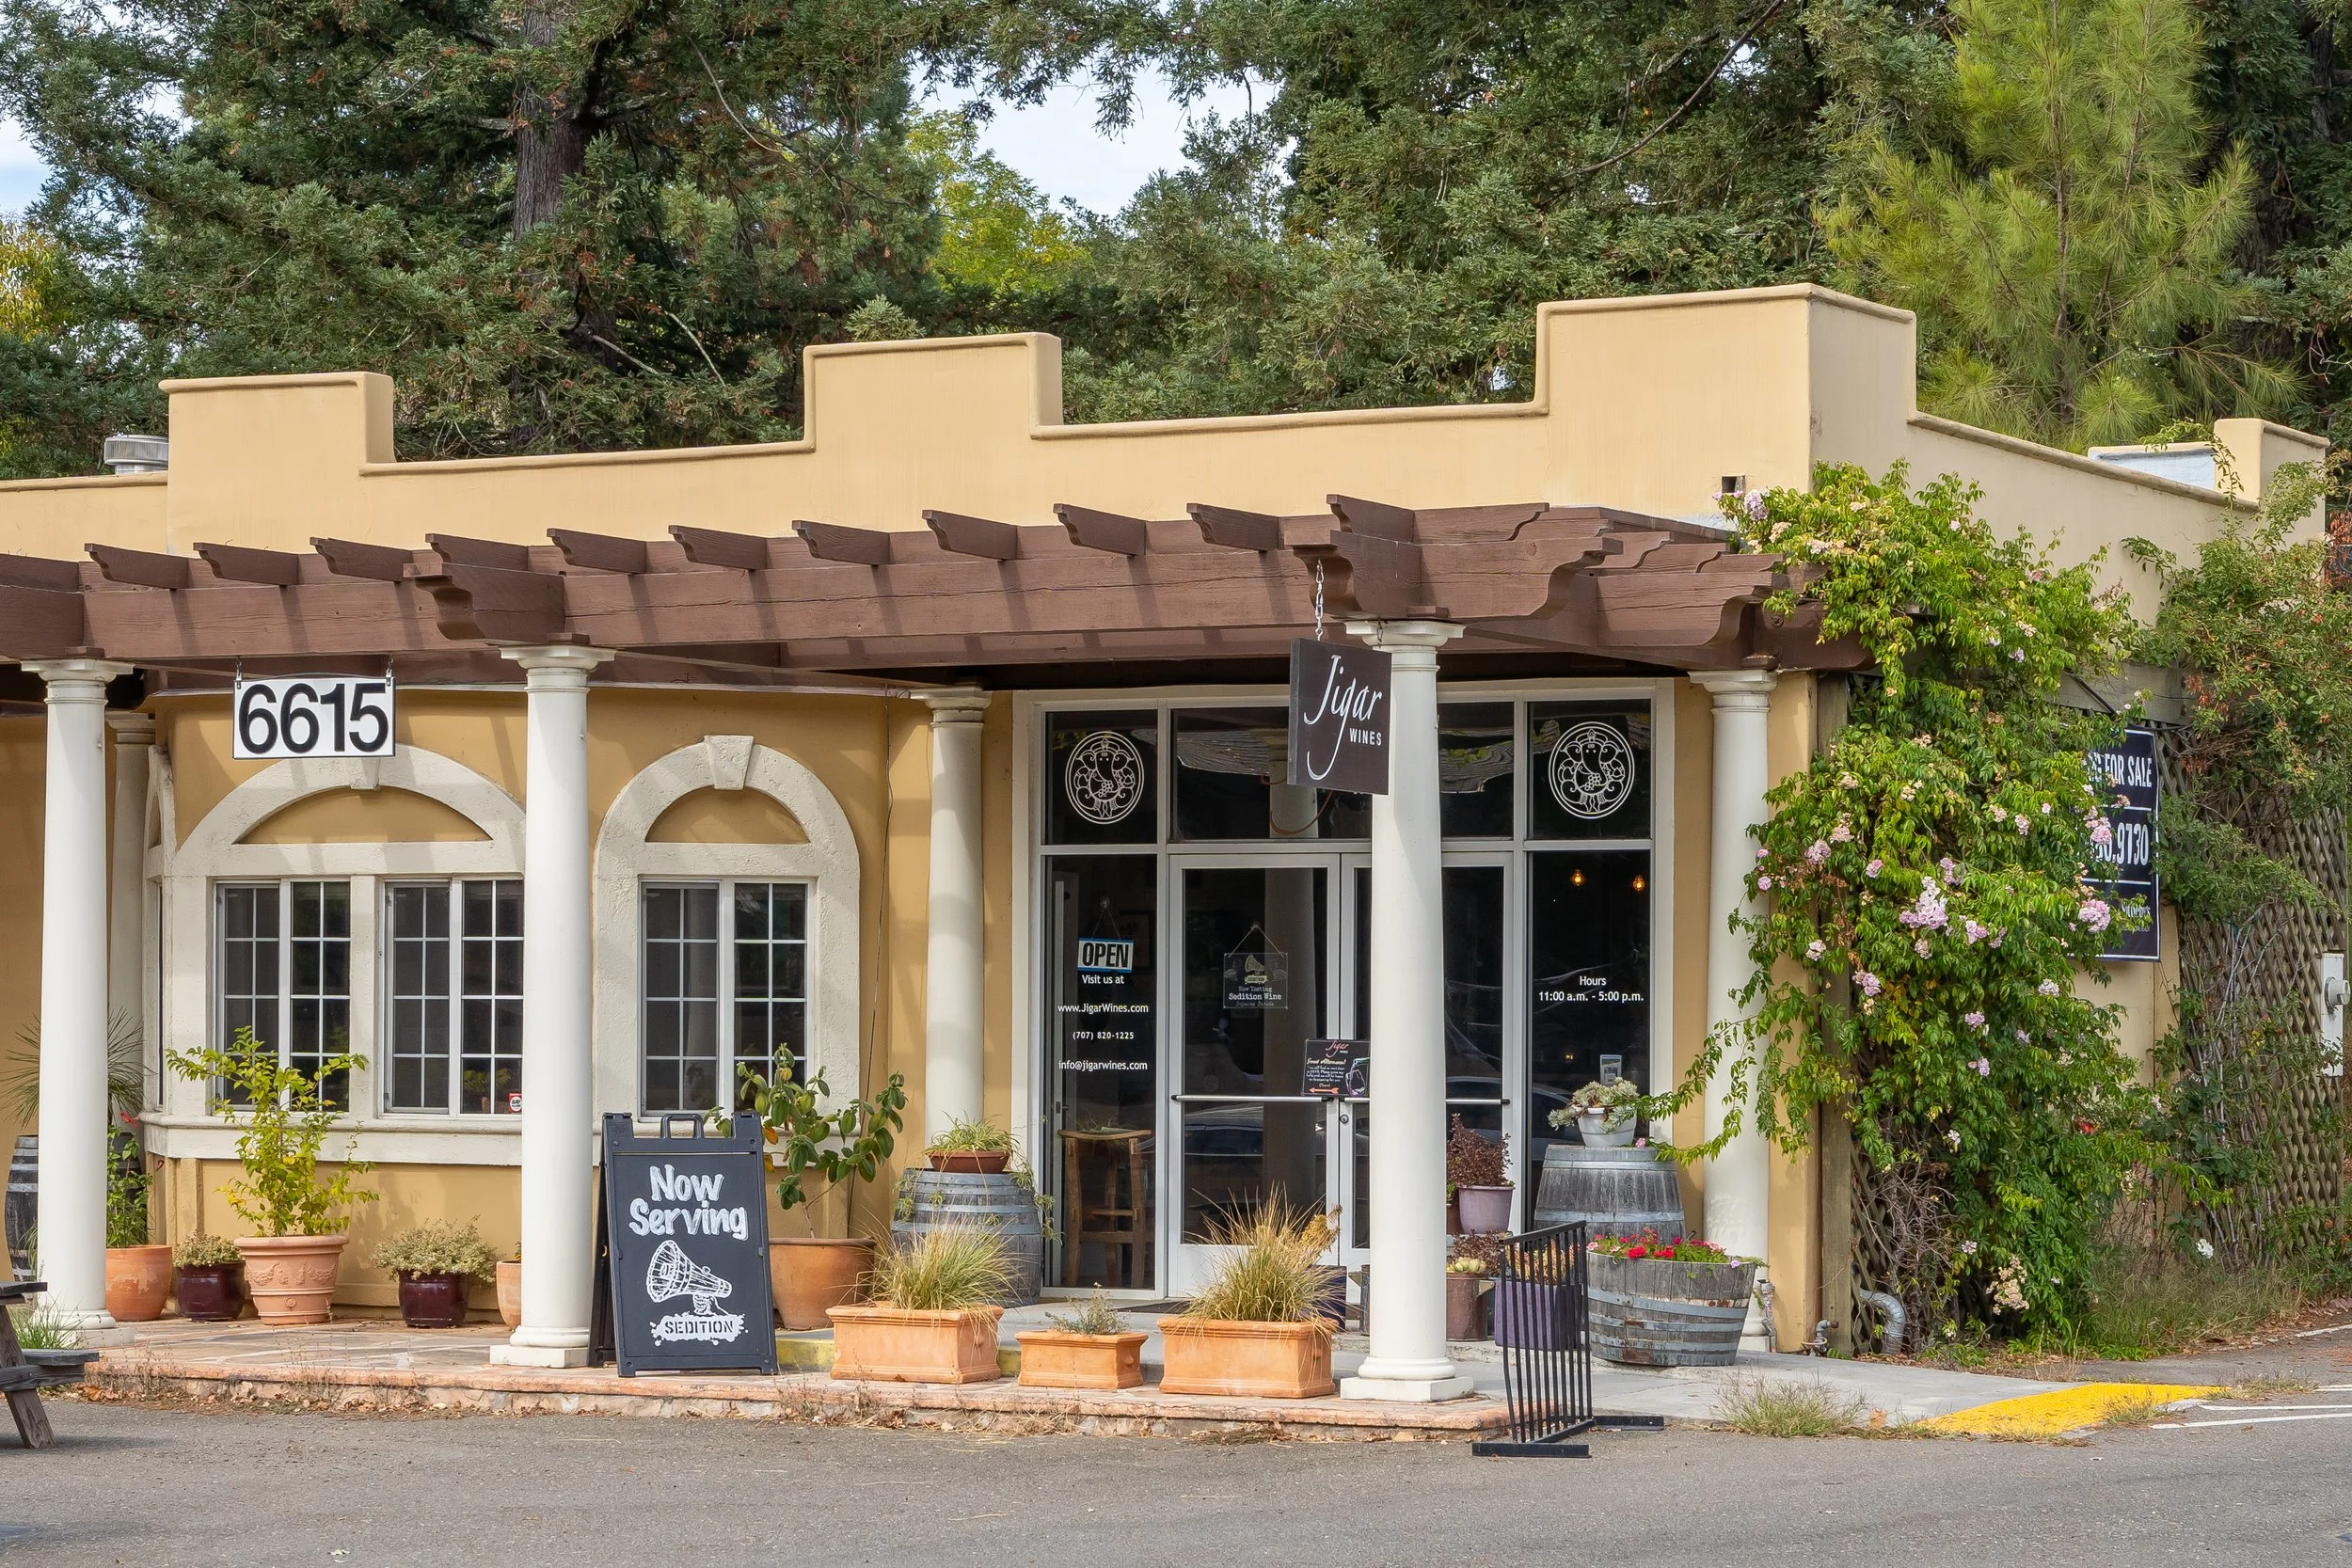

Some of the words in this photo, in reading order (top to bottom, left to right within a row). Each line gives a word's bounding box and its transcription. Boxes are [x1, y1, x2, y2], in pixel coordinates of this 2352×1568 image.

[239, 683, 389, 754] 6615
[1304, 655, 1382, 780] Jigar
[1349, 728, 1382, 746] WINES
[2105, 753, 2124, 785] FOR
[2127, 755, 2152, 787] SALE
[1082, 942, 1129, 968] OPEN
[1082, 974, 1101, 984] Visit
[1115, 975, 1124, 984] at
[1580, 975, 1607, 986] Hours
[1539, 991, 1565, 1001] 11:00
[1566, 993, 1588, 1002] a.m.
[1598, 991, 1619, 1001] 5:00
[1622, 992, 1644, 1003] p.m.
[1057, 1003, 1149, 1015] www.JigarWines.com
[1073, 1031, 1094, 1040] (707)
[1058, 1060, 1148, 1072] info@jigarwines.com
[650, 1164, 724, 1202] Now
[629, 1198, 749, 1241] Serving
[664, 1320, 734, 1335] SEDITION
